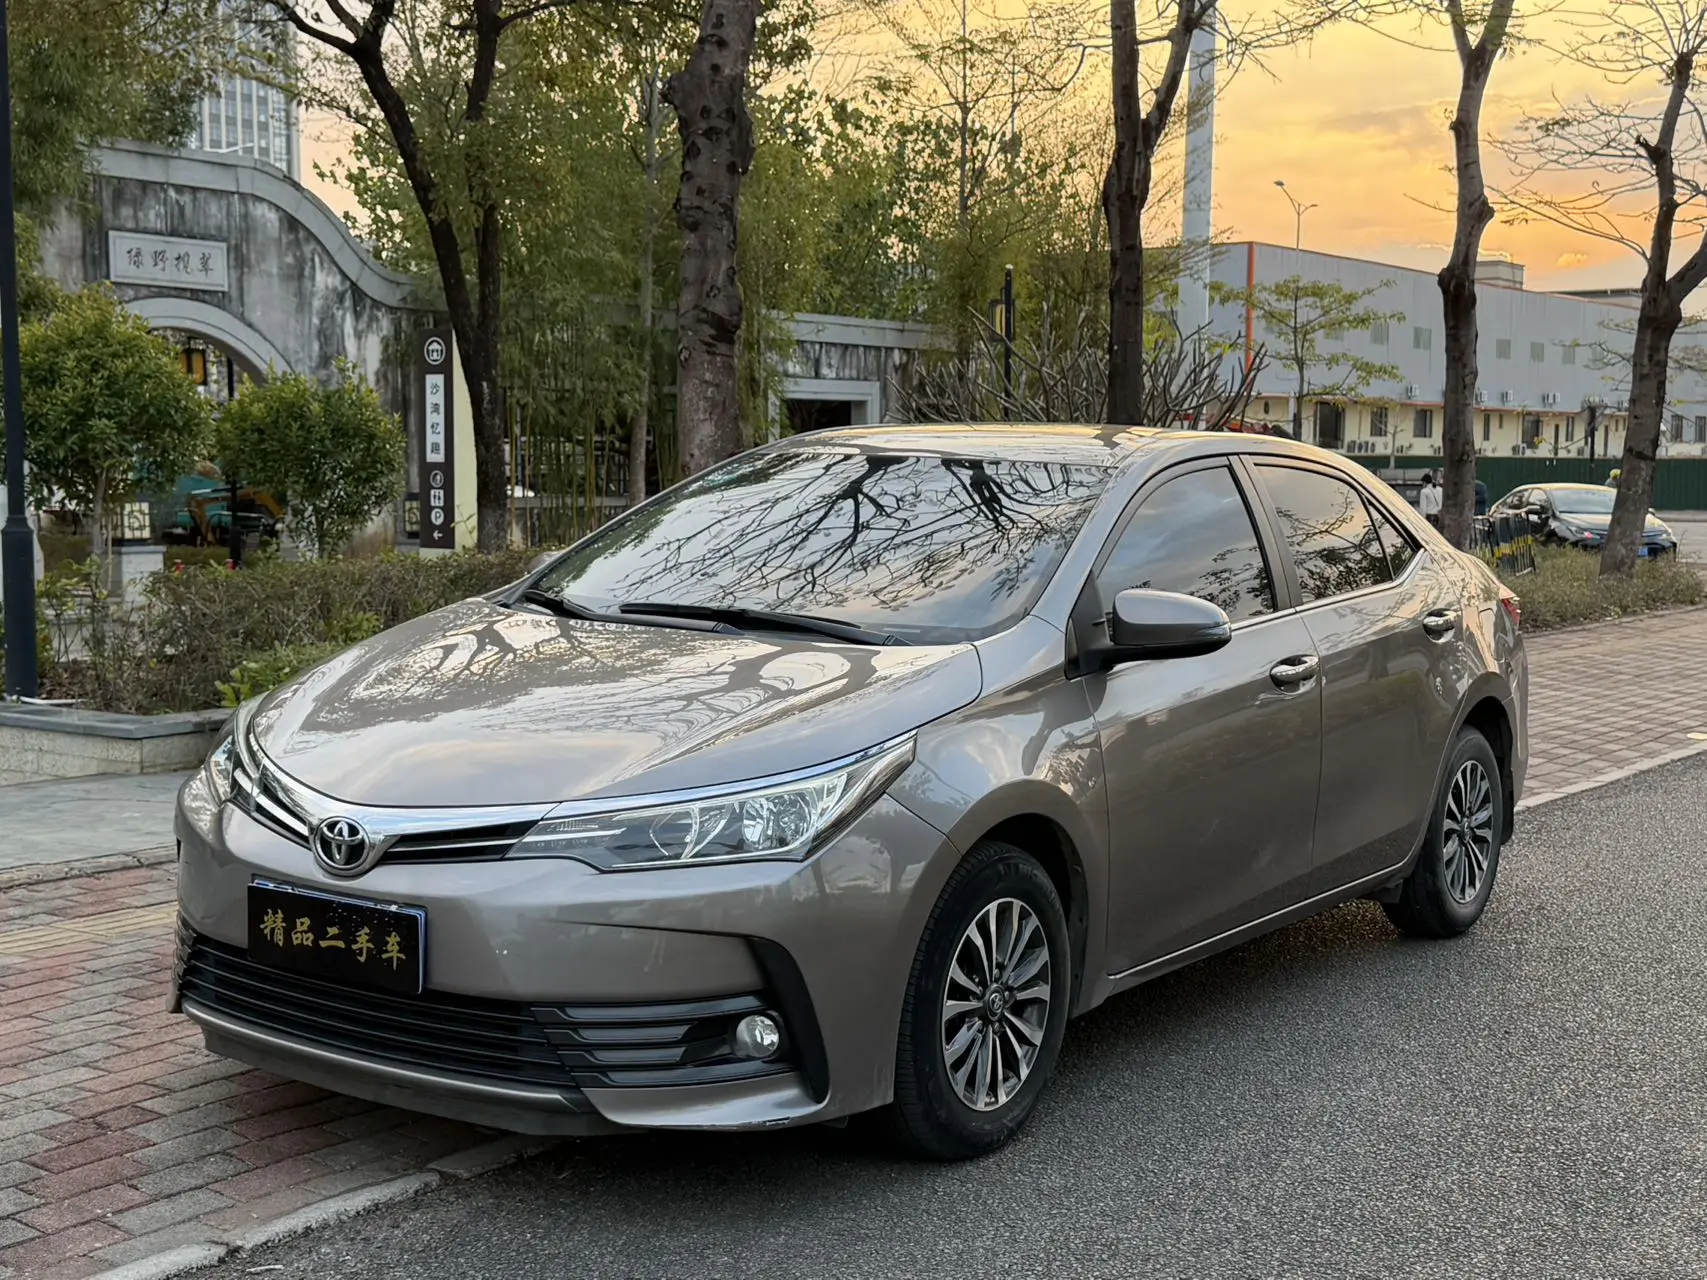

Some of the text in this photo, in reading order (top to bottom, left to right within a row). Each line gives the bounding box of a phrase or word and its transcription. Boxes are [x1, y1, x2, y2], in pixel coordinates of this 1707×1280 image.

[259, 908, 406, 971] 精品二手车
